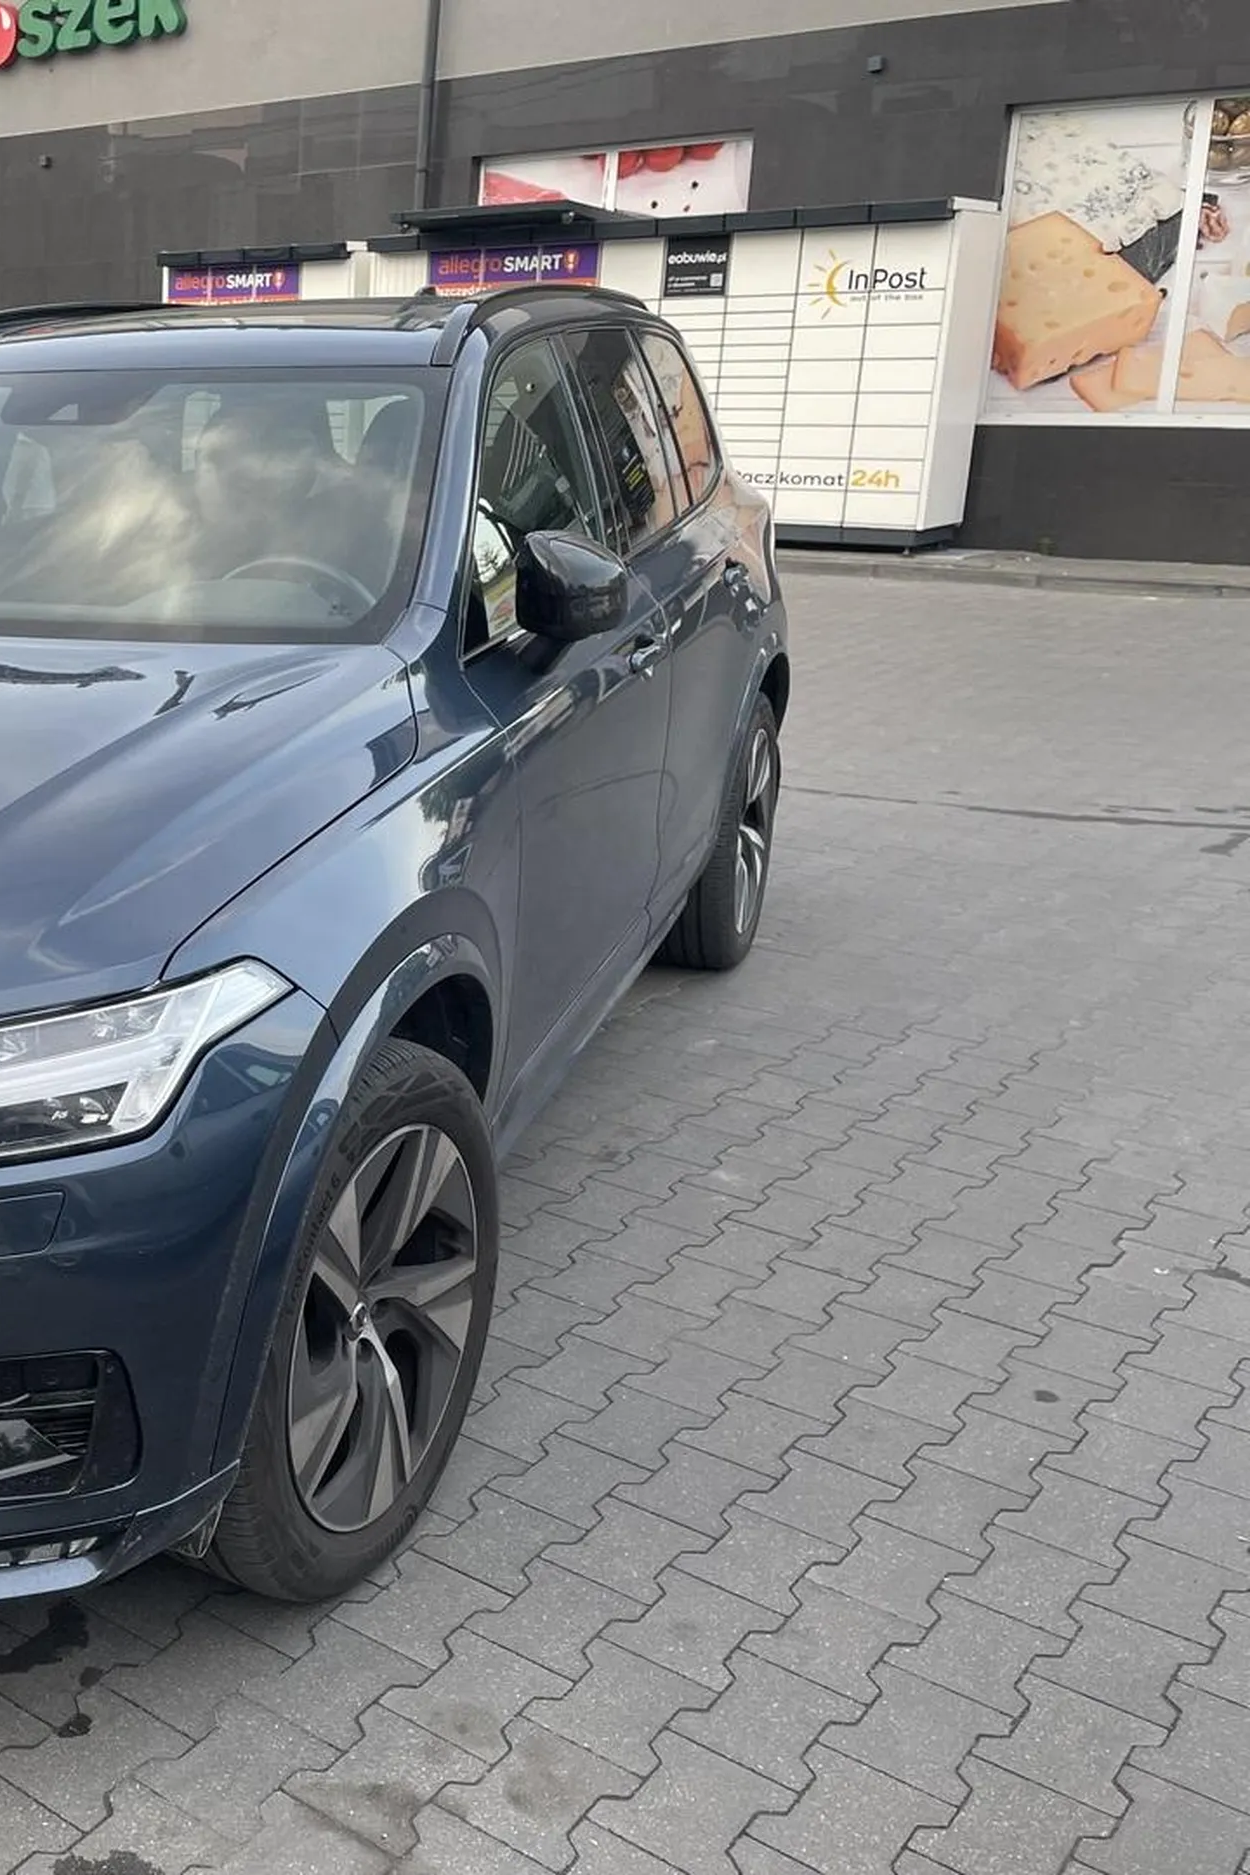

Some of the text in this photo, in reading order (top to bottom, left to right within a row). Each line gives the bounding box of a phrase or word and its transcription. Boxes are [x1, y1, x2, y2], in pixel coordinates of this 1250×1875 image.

[848, 267, 927, 290] InPost
[736, 470, 900, 488] aczkomat 24h
